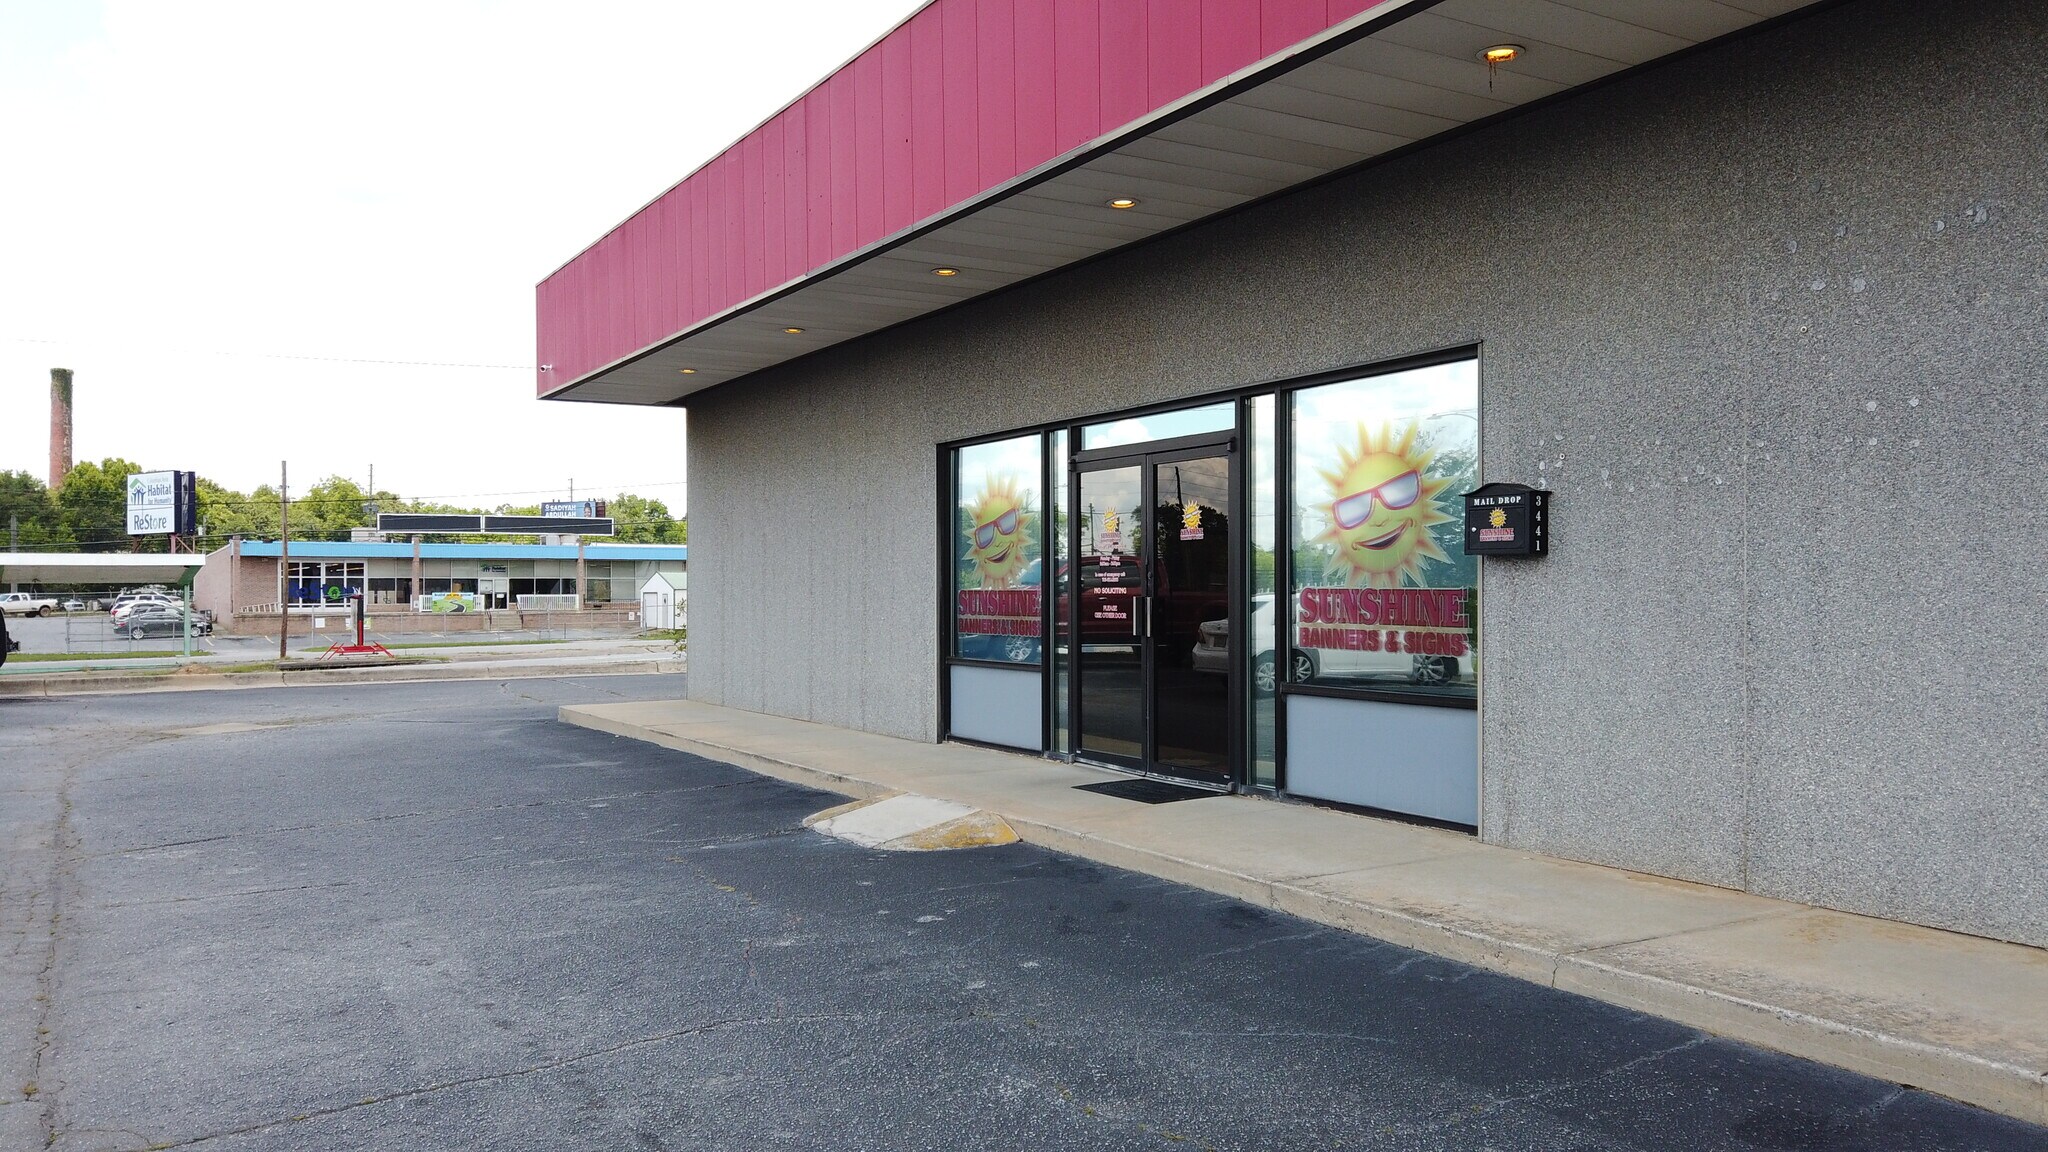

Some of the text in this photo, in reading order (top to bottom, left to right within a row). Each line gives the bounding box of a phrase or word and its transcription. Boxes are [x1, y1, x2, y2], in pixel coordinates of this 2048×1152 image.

[147, 484, 172, 497] Habitat
[1473, 496, 1521, 506] MAIL DROP
[133, 513, 167, 531] ReStore
[958, 589, 1040, 617] SUNSHINE
[1300, 588, 1468, 627] SUNSHINE
[958, 618, 998, 634] BANNERS
[1009, 619, 1041, 637] SIGNS
[1300, 627, 1469, 657] BANNERS & SIGNS
